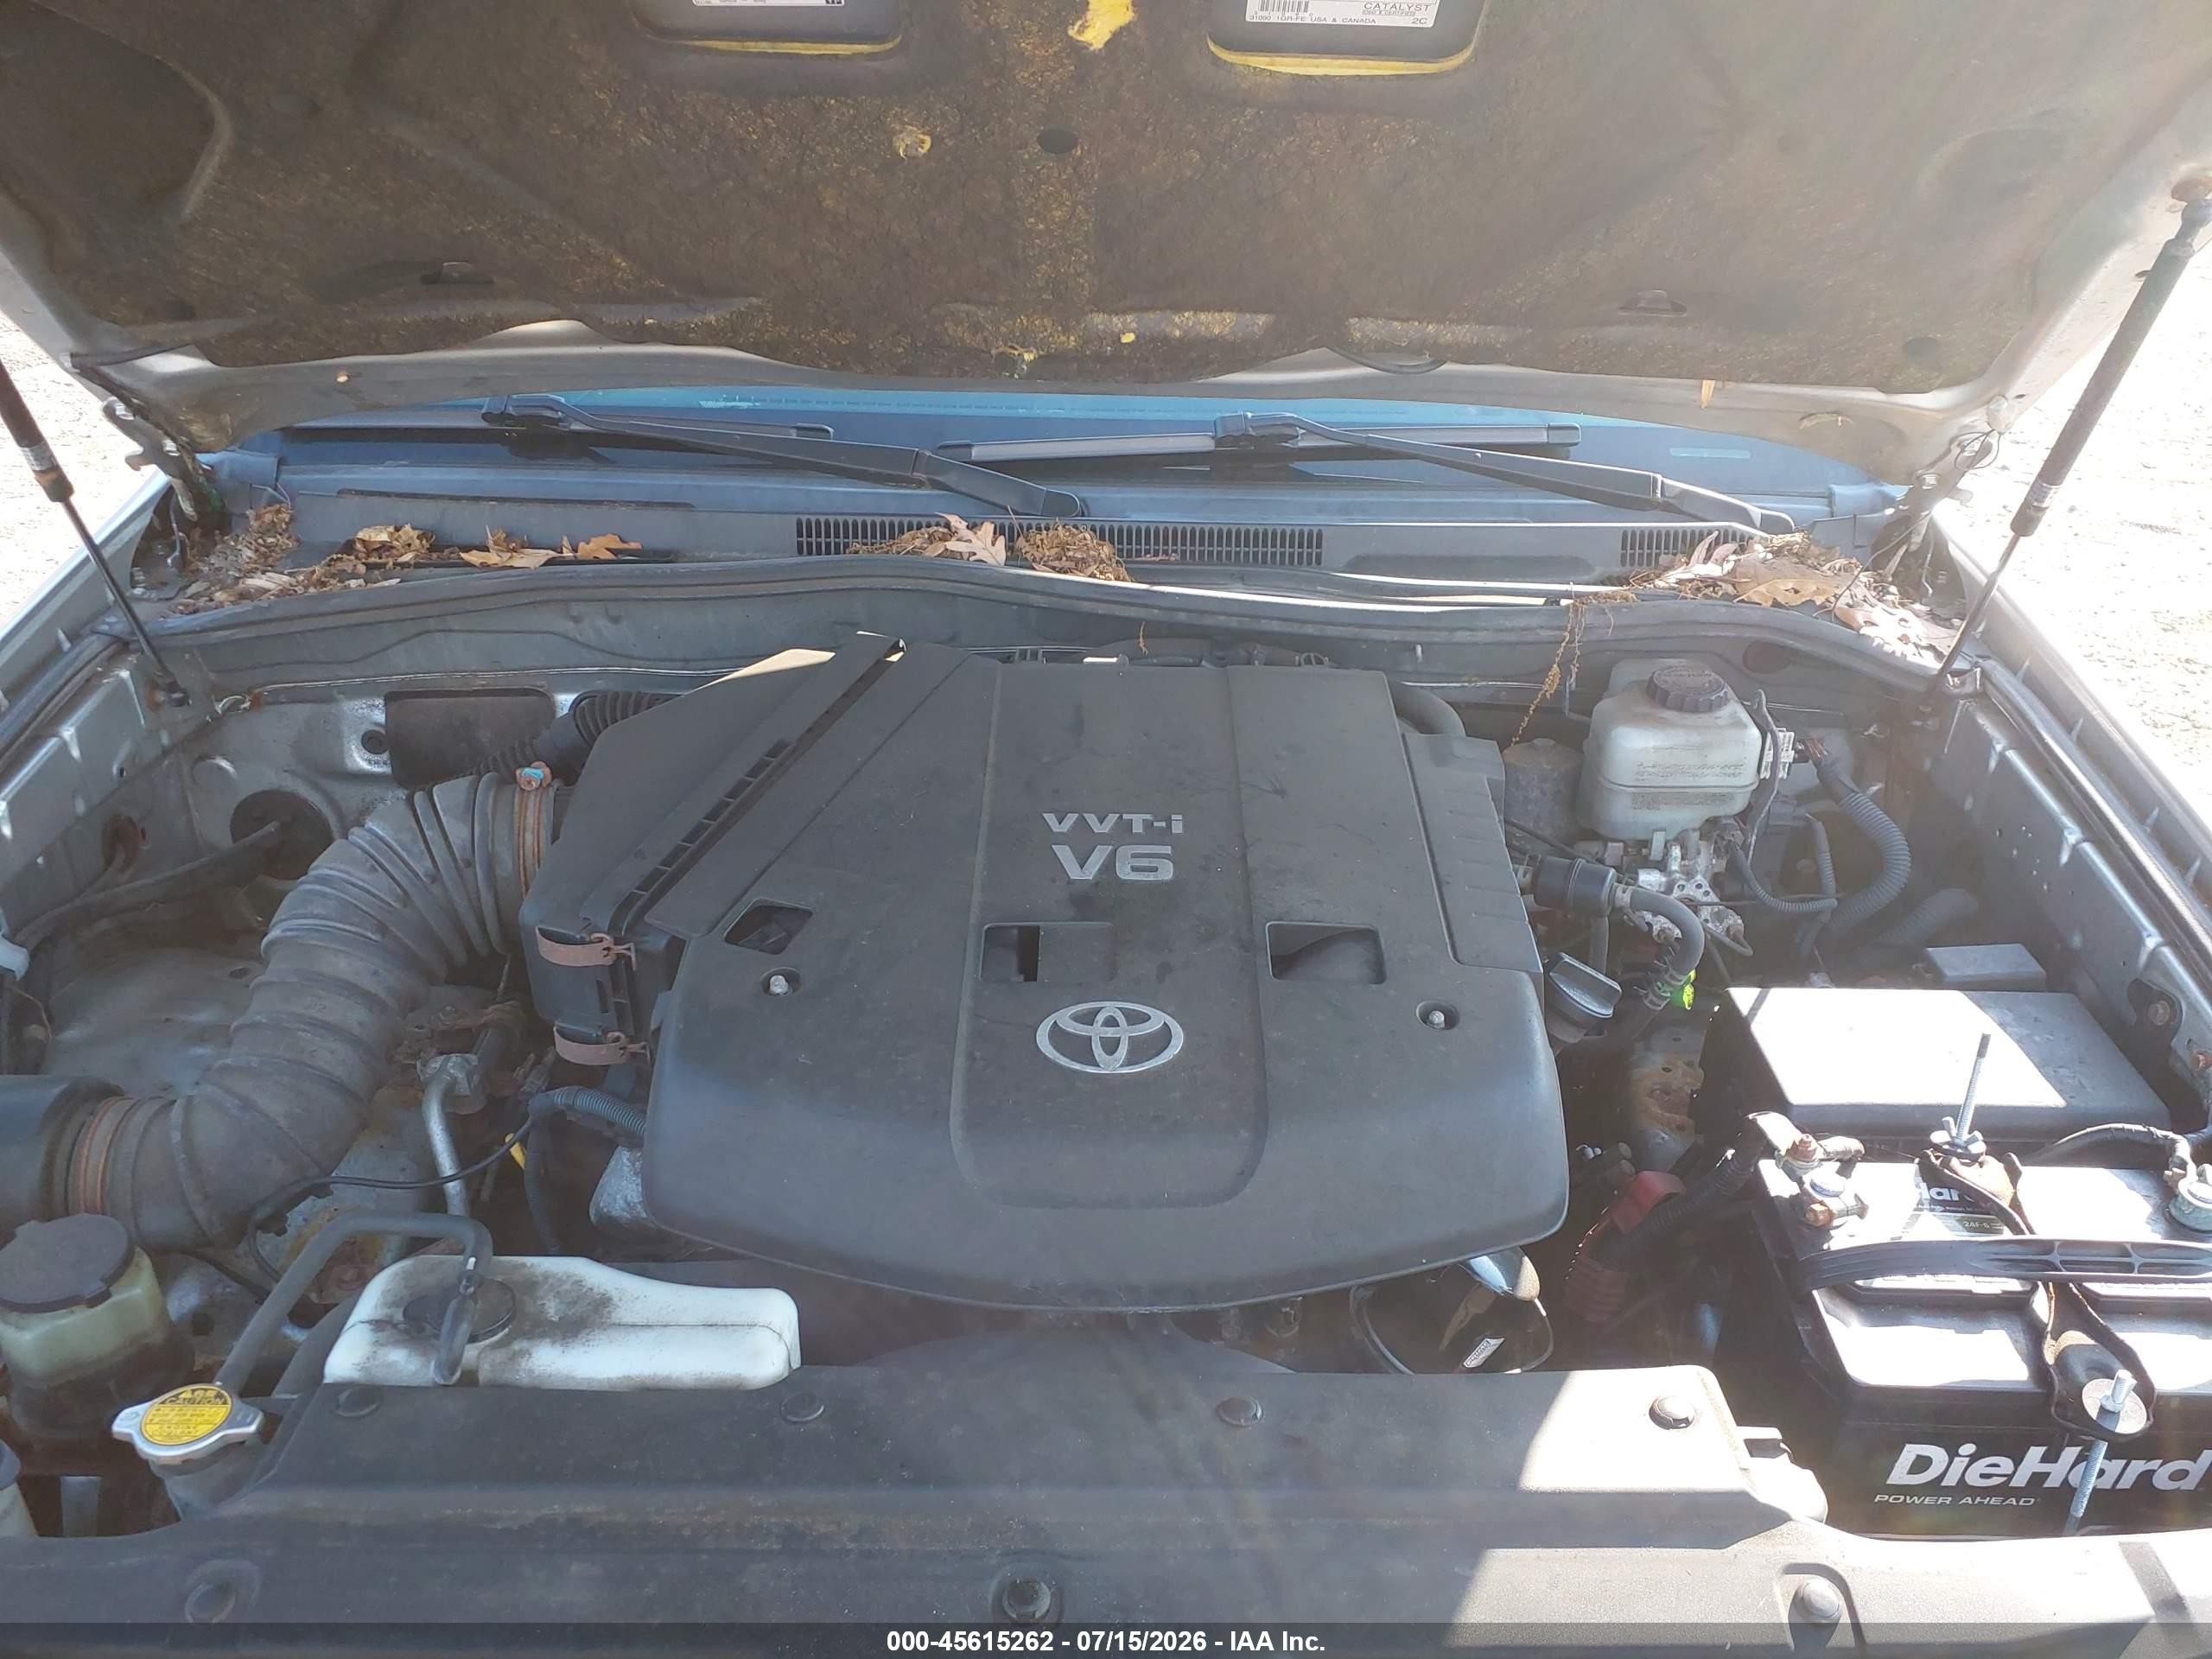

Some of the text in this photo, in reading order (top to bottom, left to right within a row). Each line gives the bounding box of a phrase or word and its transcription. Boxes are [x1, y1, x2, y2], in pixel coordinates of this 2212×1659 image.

[1363, 3, 1432, 12] CATALYST
[1042, 812, 1183, 834] VVT-i
[1051, 844, 1173, 880] V6
[1886, 1444, 2212, 1491] DieHard
[1874, 1494, 2036, 1507] POWER AHEAD
